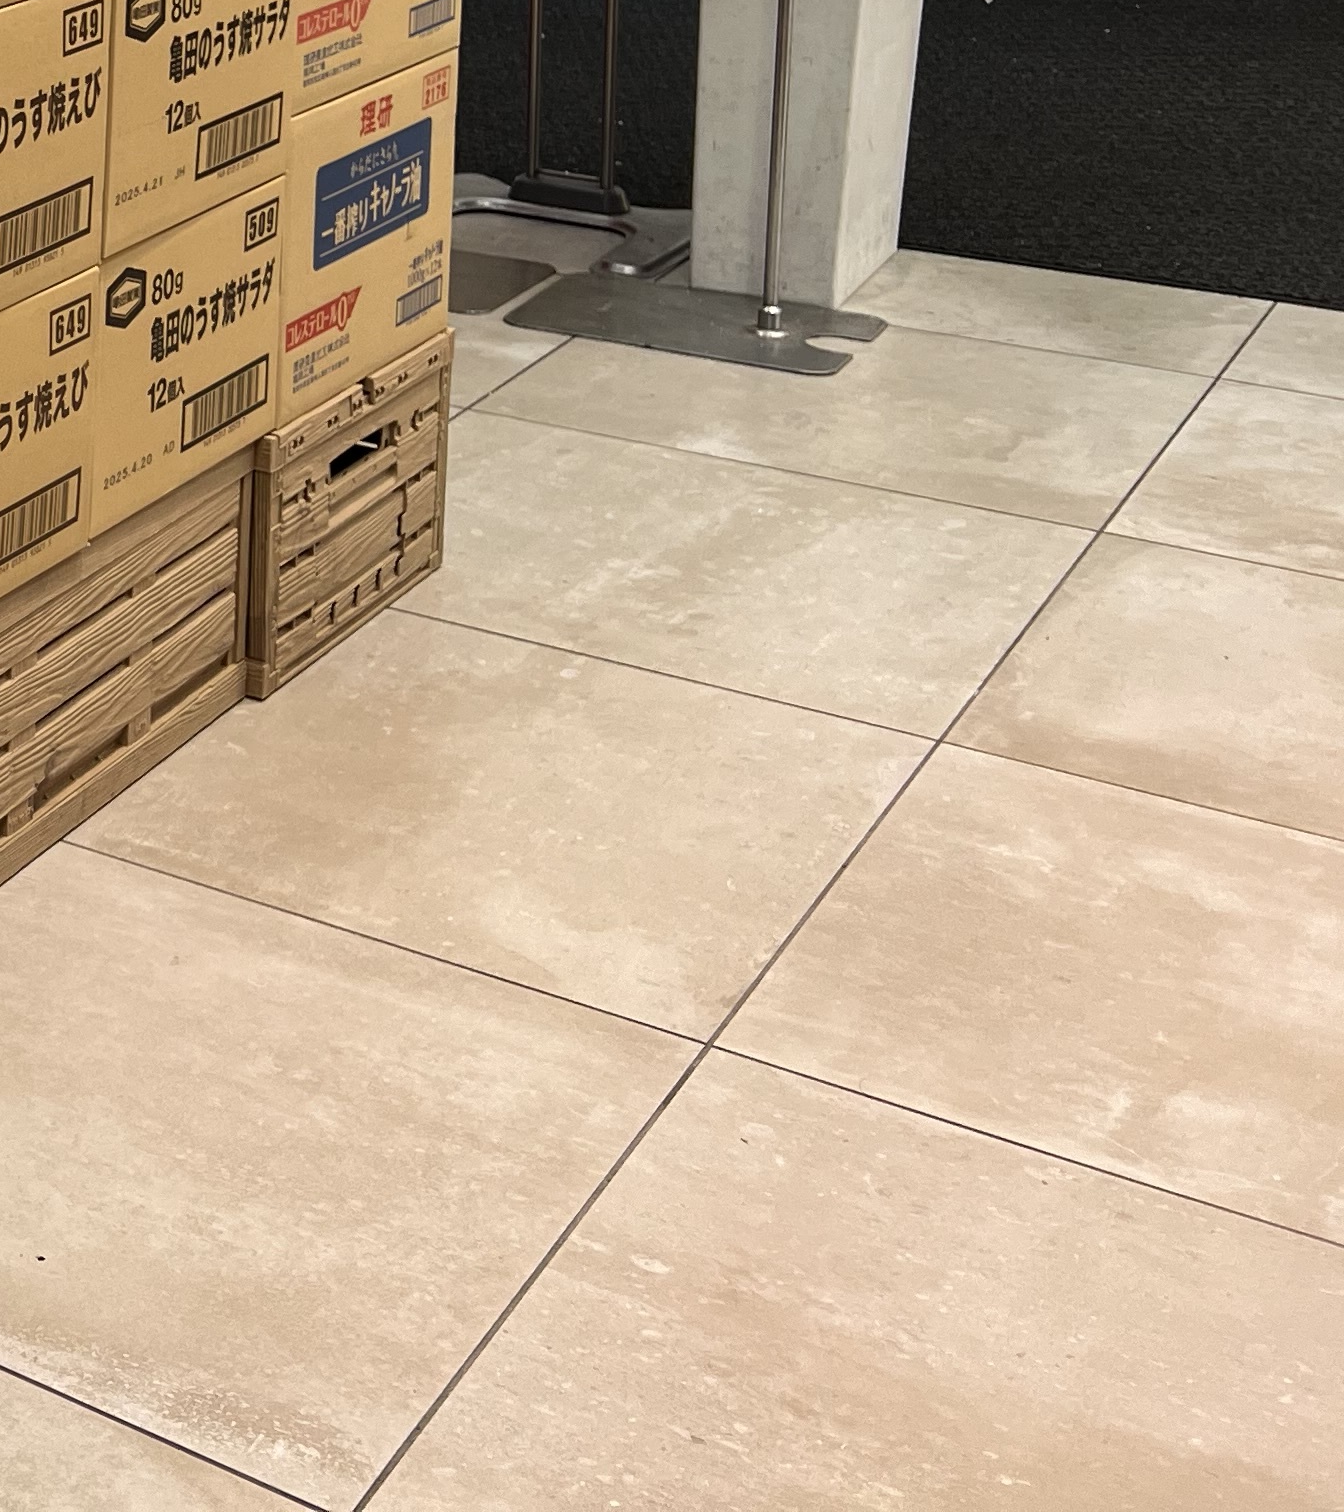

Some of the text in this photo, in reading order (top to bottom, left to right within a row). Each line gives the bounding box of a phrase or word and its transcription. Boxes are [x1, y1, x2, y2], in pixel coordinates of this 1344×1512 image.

[66, 3, 100, 51] 649
[165, 99, 202, 135] 12個入
[360, 94, 393, 138] 理研
[248, 202, 277, 247] 509
[150, 269, 184, 304] 80g
[53, 300, 88, 350] 649
[150, 256, 277, 364] 亀田のうす焼サラダ
[146, 376, 186, 413] 12個入
